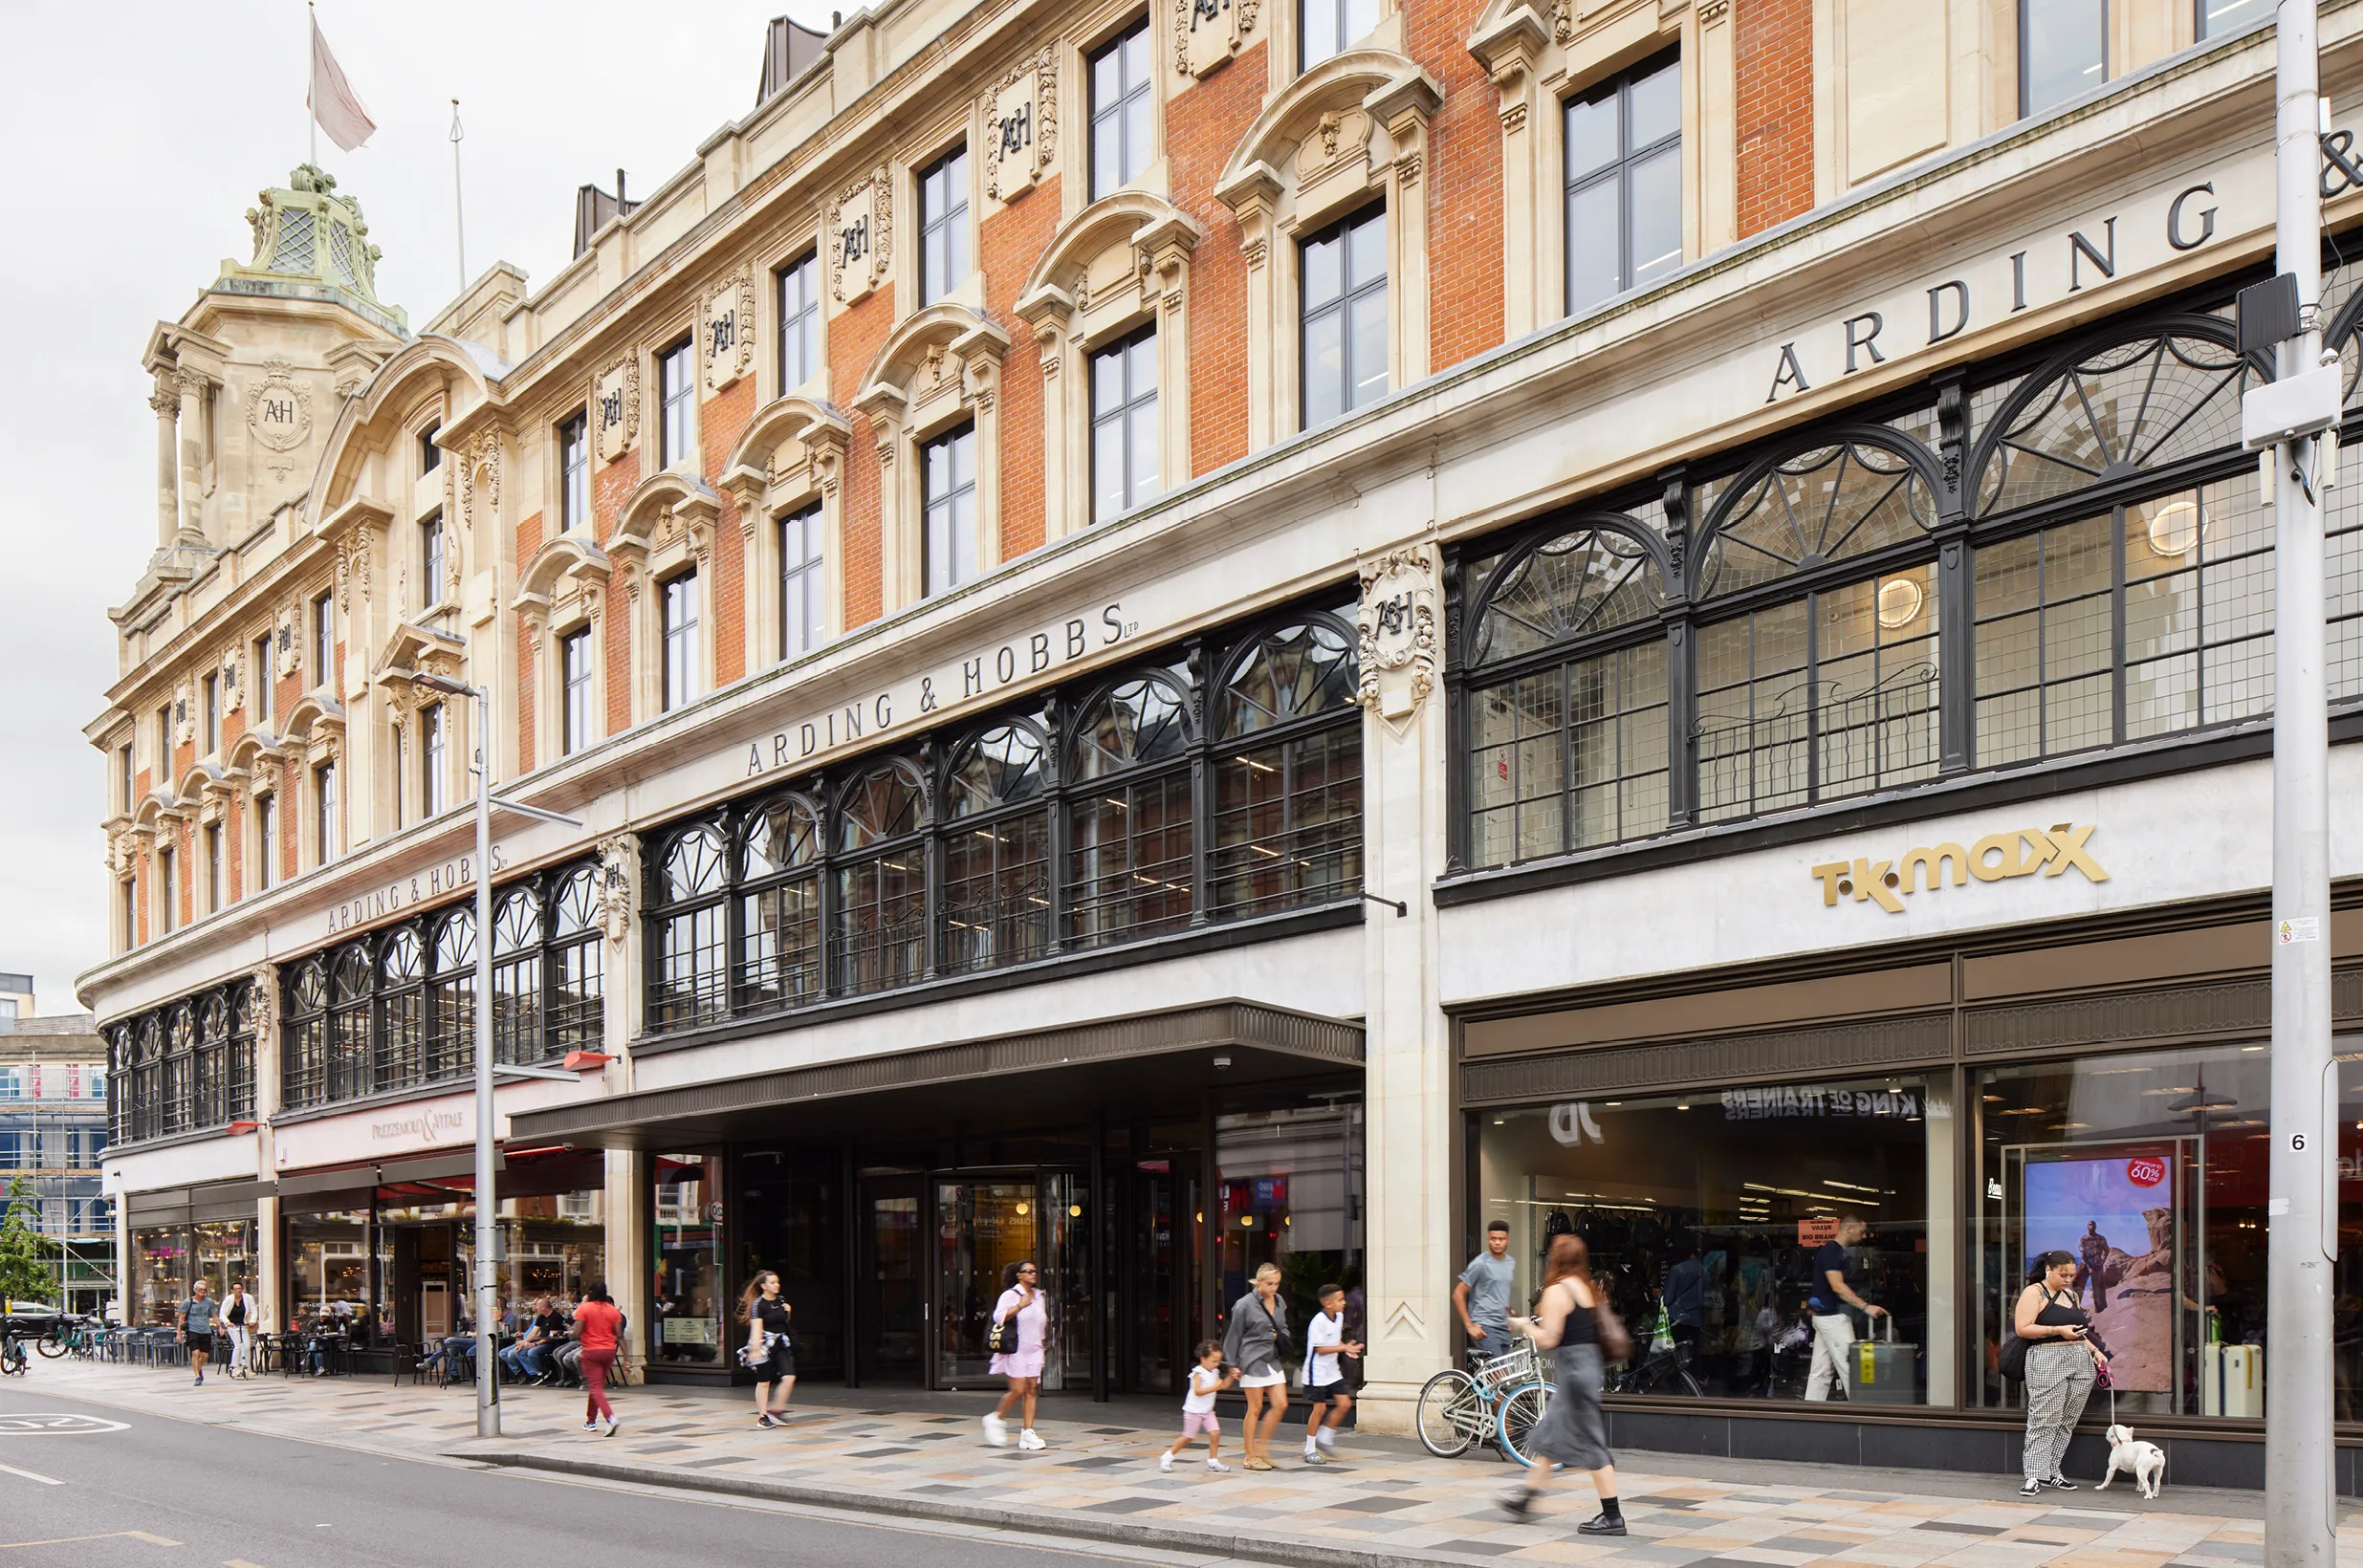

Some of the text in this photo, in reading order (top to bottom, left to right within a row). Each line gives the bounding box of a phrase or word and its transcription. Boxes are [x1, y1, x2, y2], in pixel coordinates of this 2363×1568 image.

[1767, 130, 2363, 403] ARDING &
[747, 693, 891, 777] ARDING
[920, 677, 938, 712] &
[963, 603, 1123, 699] HOBBS
[328, 885, 399, 934] ARDING
[411, 878, 421, 903] &
[430, 845, 501, 896] HOBS
[433, 1111, 464, 1129] VITALE
[2292, 1135, 2306, 1151] 6
